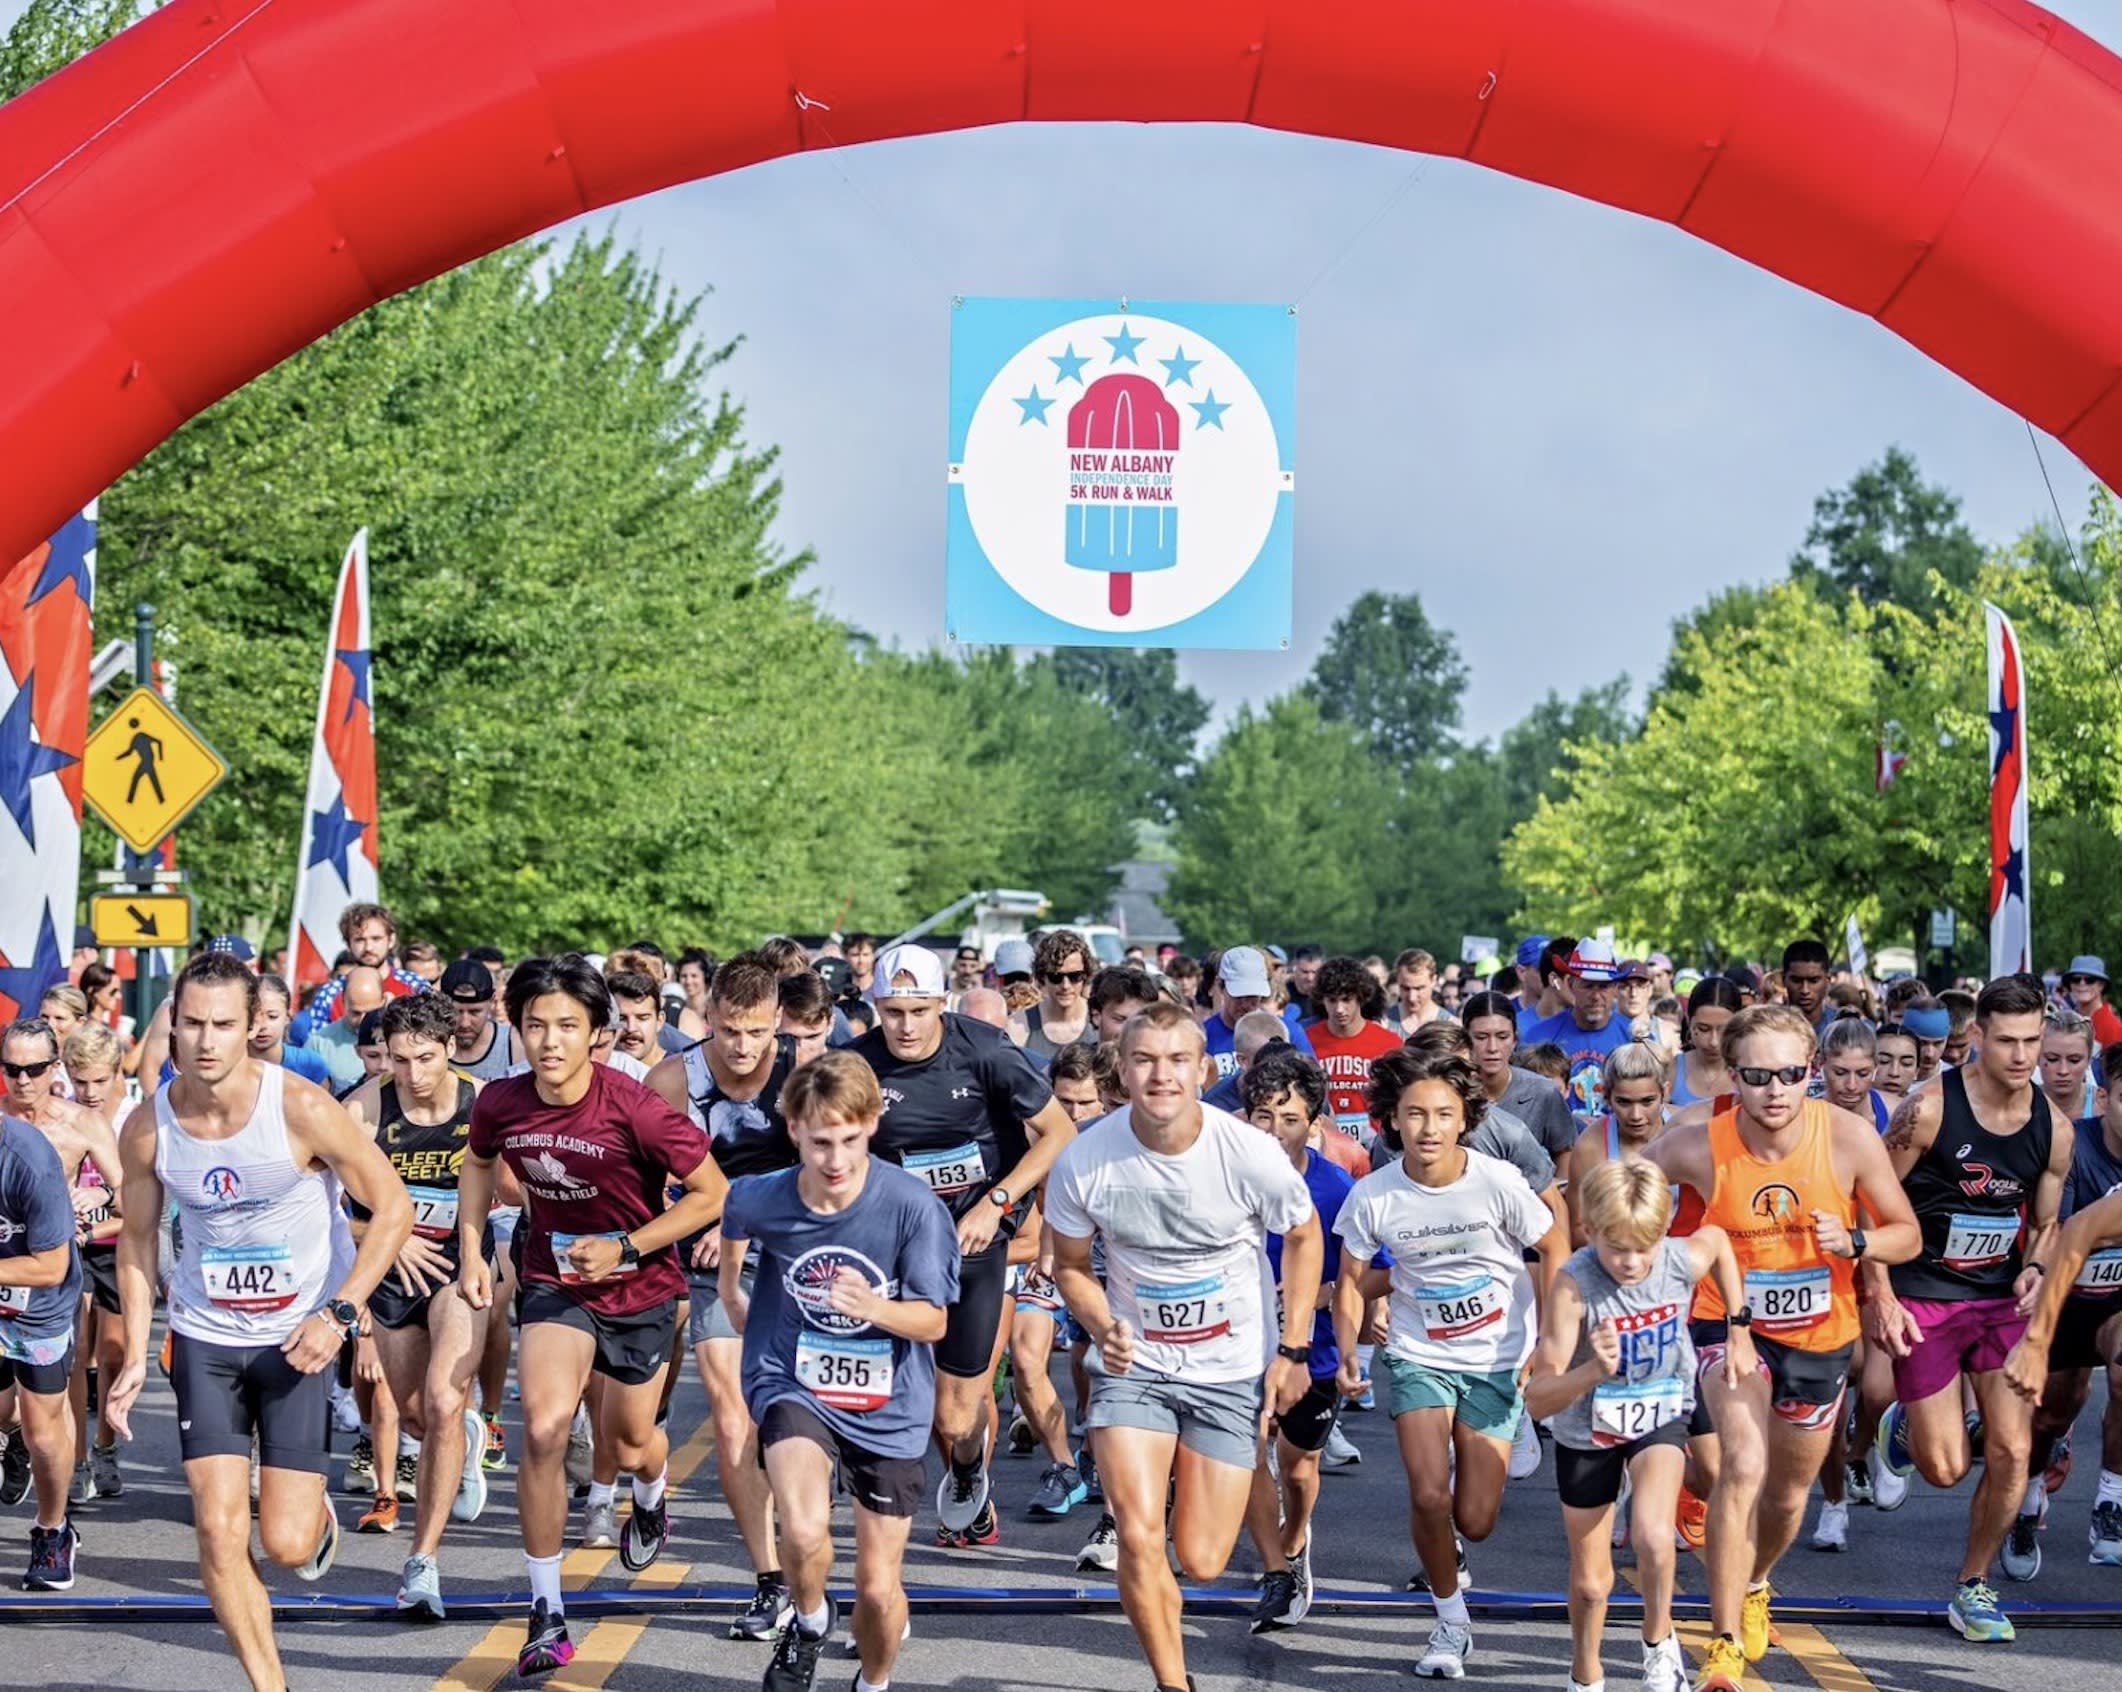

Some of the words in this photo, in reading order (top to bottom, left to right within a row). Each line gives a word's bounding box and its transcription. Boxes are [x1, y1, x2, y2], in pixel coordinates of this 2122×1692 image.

[1070, 454, 1107, 471] NEW
[1110, 455, 1174, 473] ALBANY
[1070, 472, 1150, 485] INDEPENDENCE
[1153, 475, 1173, 486] DAY
[1070, 485, 1087, 499] 5K
[1091, 486, 1119, 499] RUN
[1122, 487, 1134, 500] &
[1136, 487, 1173, 501] WALK
[505, 1133, 554, 1149] COLUMBUS
[555, 1135, 605, 1160] ACADEMY
[390, 1150, 452, 1168] FLEET
[396, 1164, 446, 1180] FEET
[925, 1164, 967, 1186] 153
[571, 1185, 599, 1199] FIELD
[1419, 1247, 1467, 1258] MAUI
[1963, 1232, 2002, 1256] 770
[226, 1265, 277, 1294] 442
[1437, 1296, 1483, 1324] 846
[1765, 1287, 1812, 1315] 820
[1158, 1299, 1206, 1328] 627
[818, 1355, 870, 1387] 355
[1616, 1401, 1661, 1434] 121
